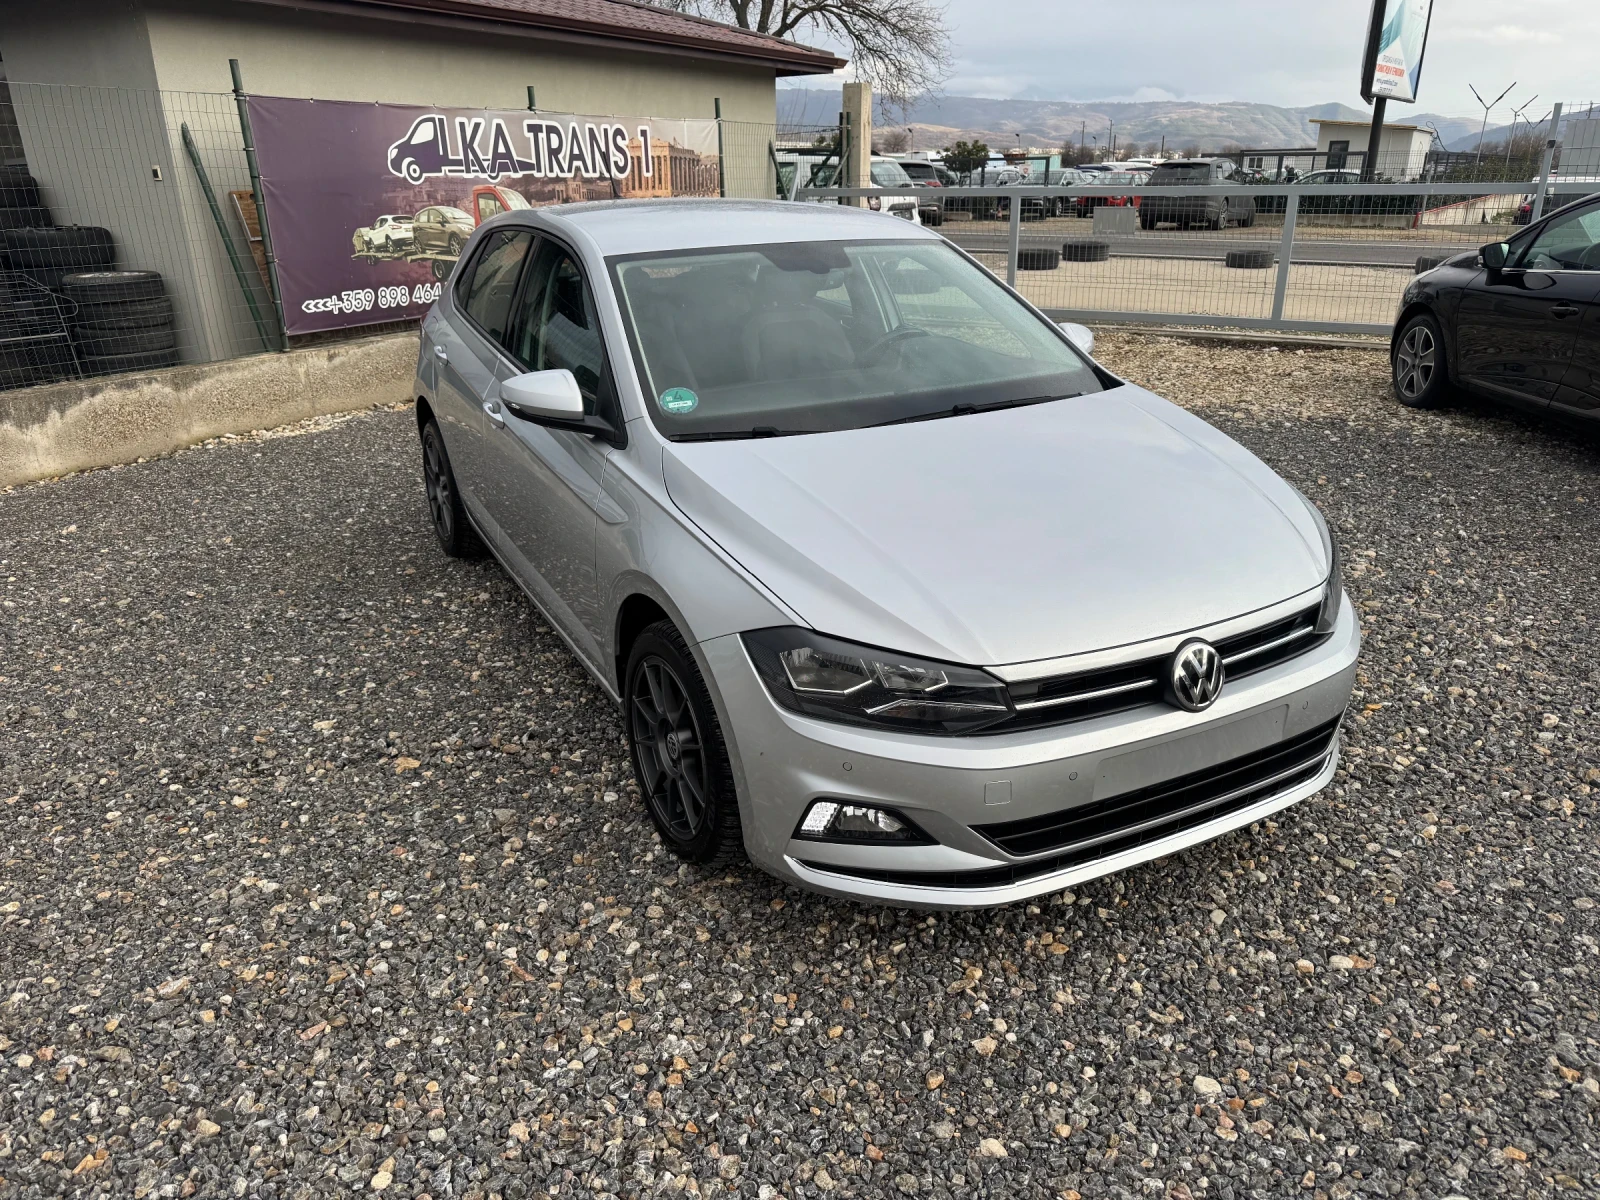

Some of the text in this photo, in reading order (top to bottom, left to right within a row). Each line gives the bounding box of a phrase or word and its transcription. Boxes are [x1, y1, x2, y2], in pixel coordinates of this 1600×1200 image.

[525, 122, 630, 176] TRANS
[639, 127, 651, 175] 1
[331, 283, 441, 313] +359 898 464
[674, 391, 683, 400] 4
[1175, 644, 1222, 709] VW
